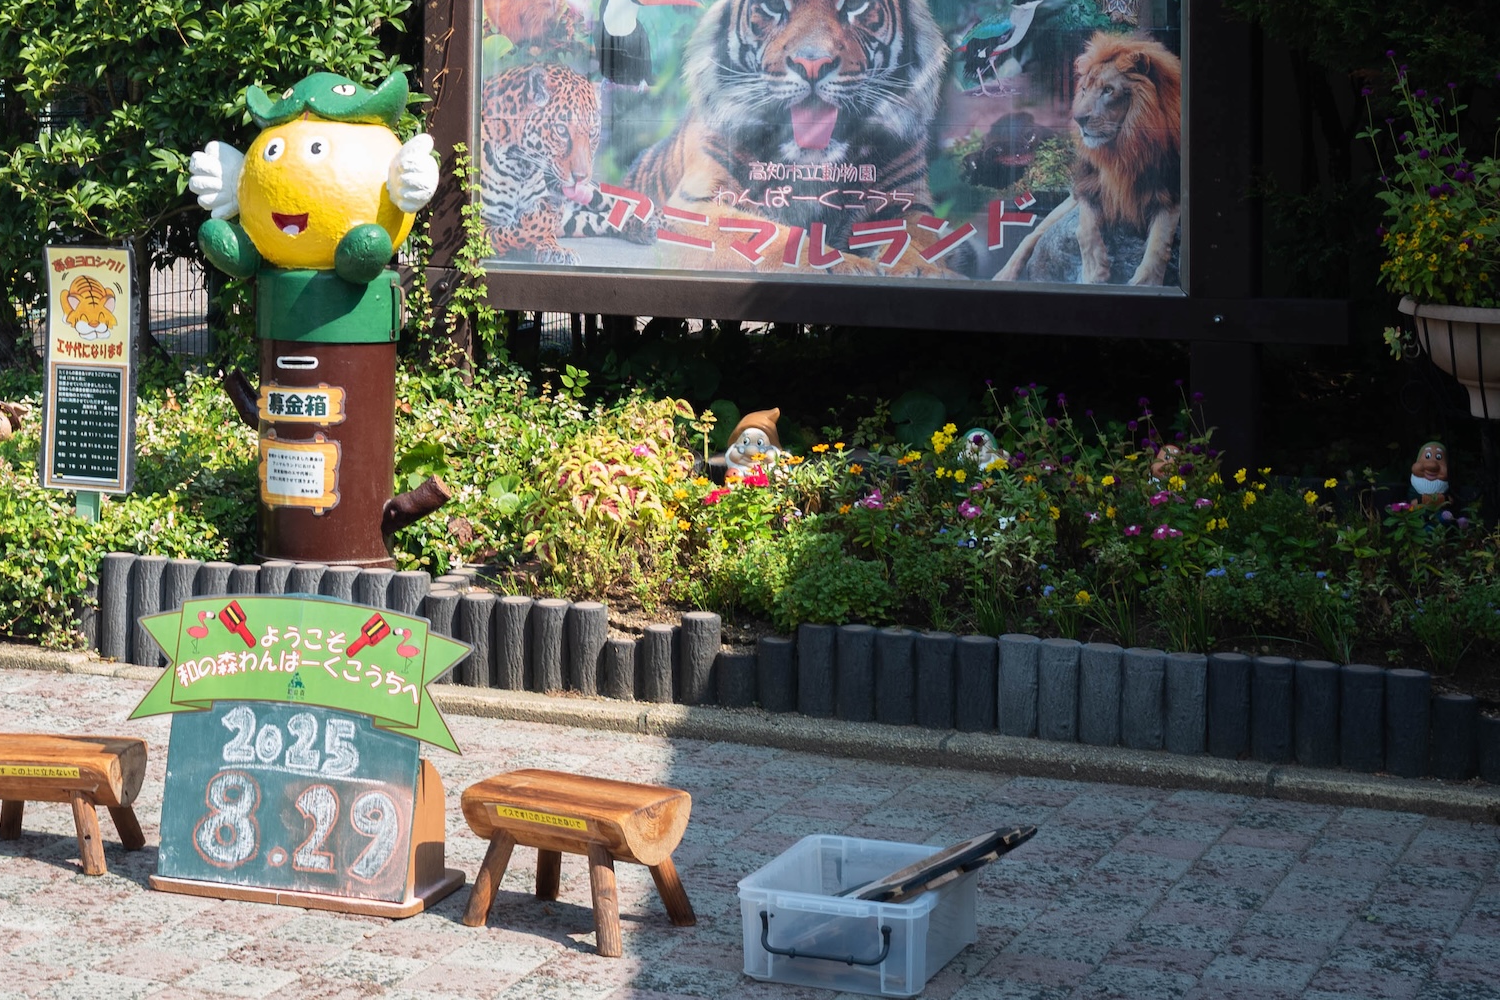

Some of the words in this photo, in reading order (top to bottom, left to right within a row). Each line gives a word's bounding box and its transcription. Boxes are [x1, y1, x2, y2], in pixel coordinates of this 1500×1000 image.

[748, 160, 877, 183] 高知市立動物園
[712, 185, 915, 214] わんぱーくこうち
[598, 183, 1038, 270] アニマルランド
[57, 338, 123, 359] エサ代になります
[269, 392, 327, 416] 募金箱
[259, 625, 348, 655] ようこそ
[220, 705, 360, 776] 2025
[10, 767, 79, 777] この上に立たないで
